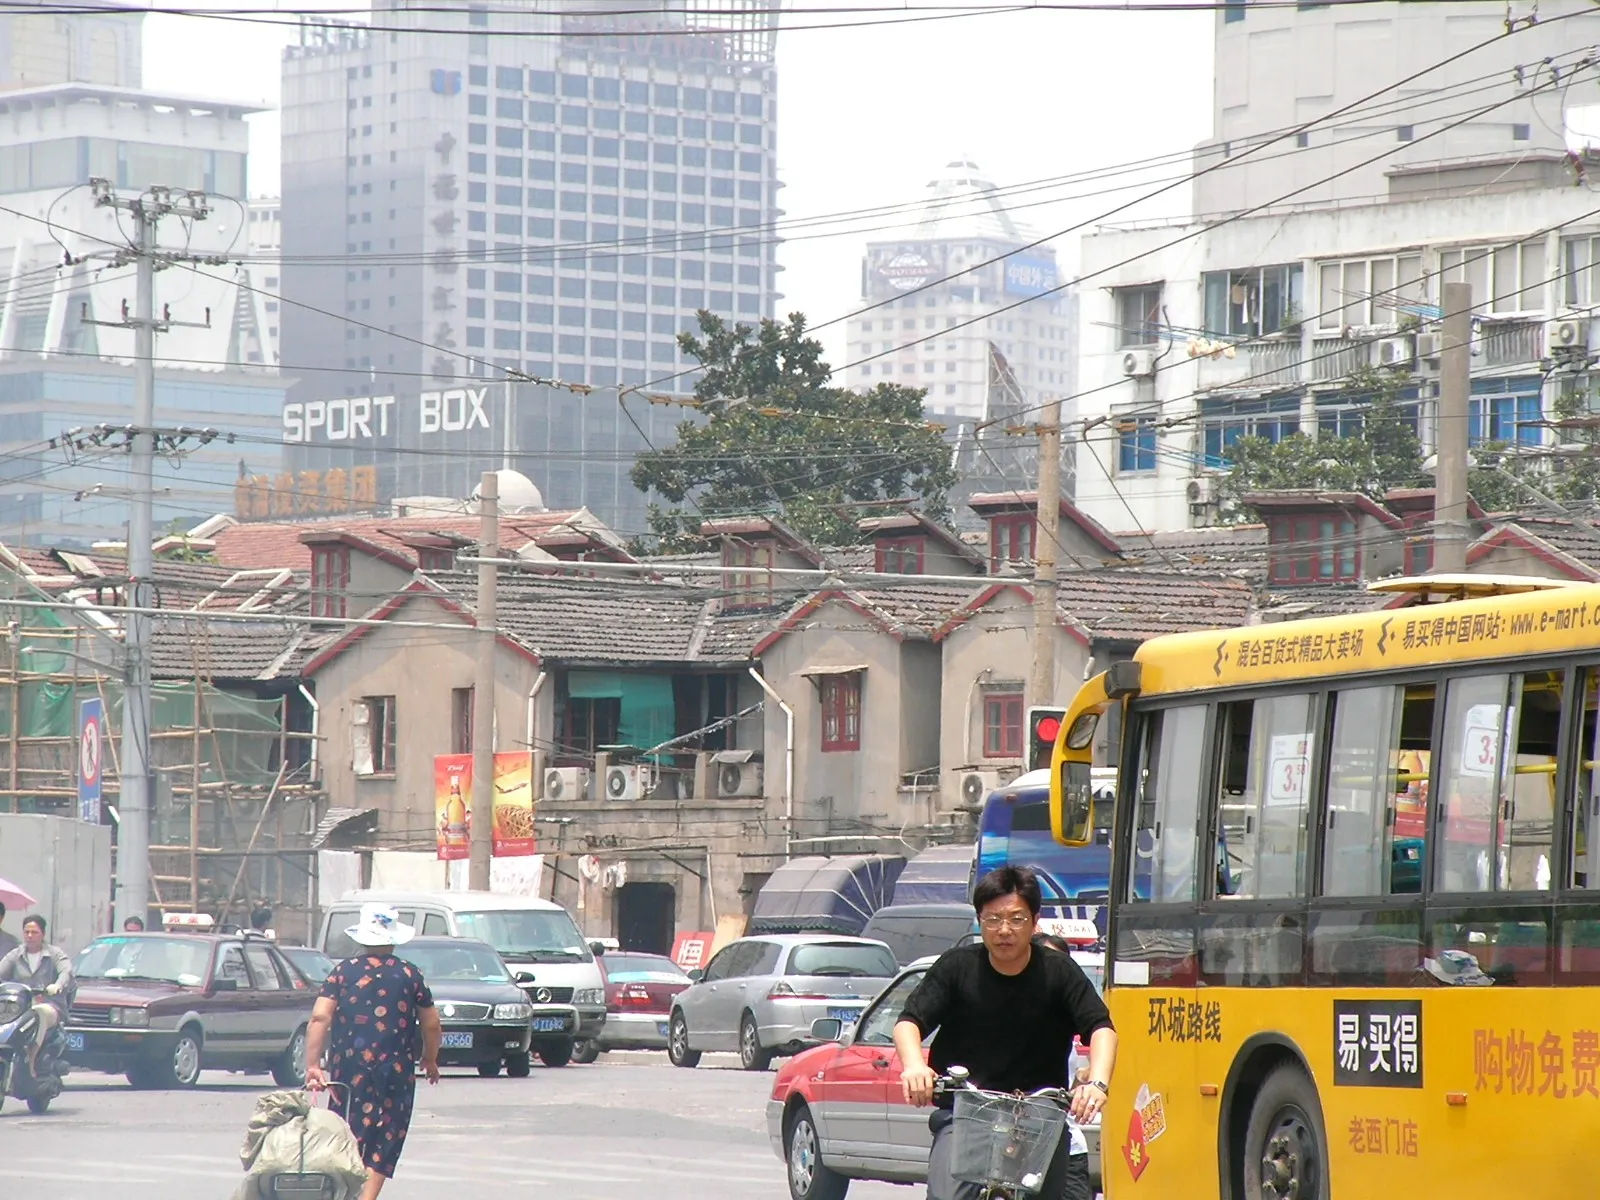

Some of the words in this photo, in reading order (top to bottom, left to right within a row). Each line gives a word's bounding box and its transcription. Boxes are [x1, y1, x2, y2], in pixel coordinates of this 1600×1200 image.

[283, 396, 395, 442] SPORT
[420, 387, 490, 433] BOX
[1236, 629, 1364, 668] 混合百货式精品大卖场
[1147, 997, 1222, 1043] 环城路线
[1473, 1028, 1600, 1100] 购物免费
[1348, 1115, 1418, 1158] 老西门店
